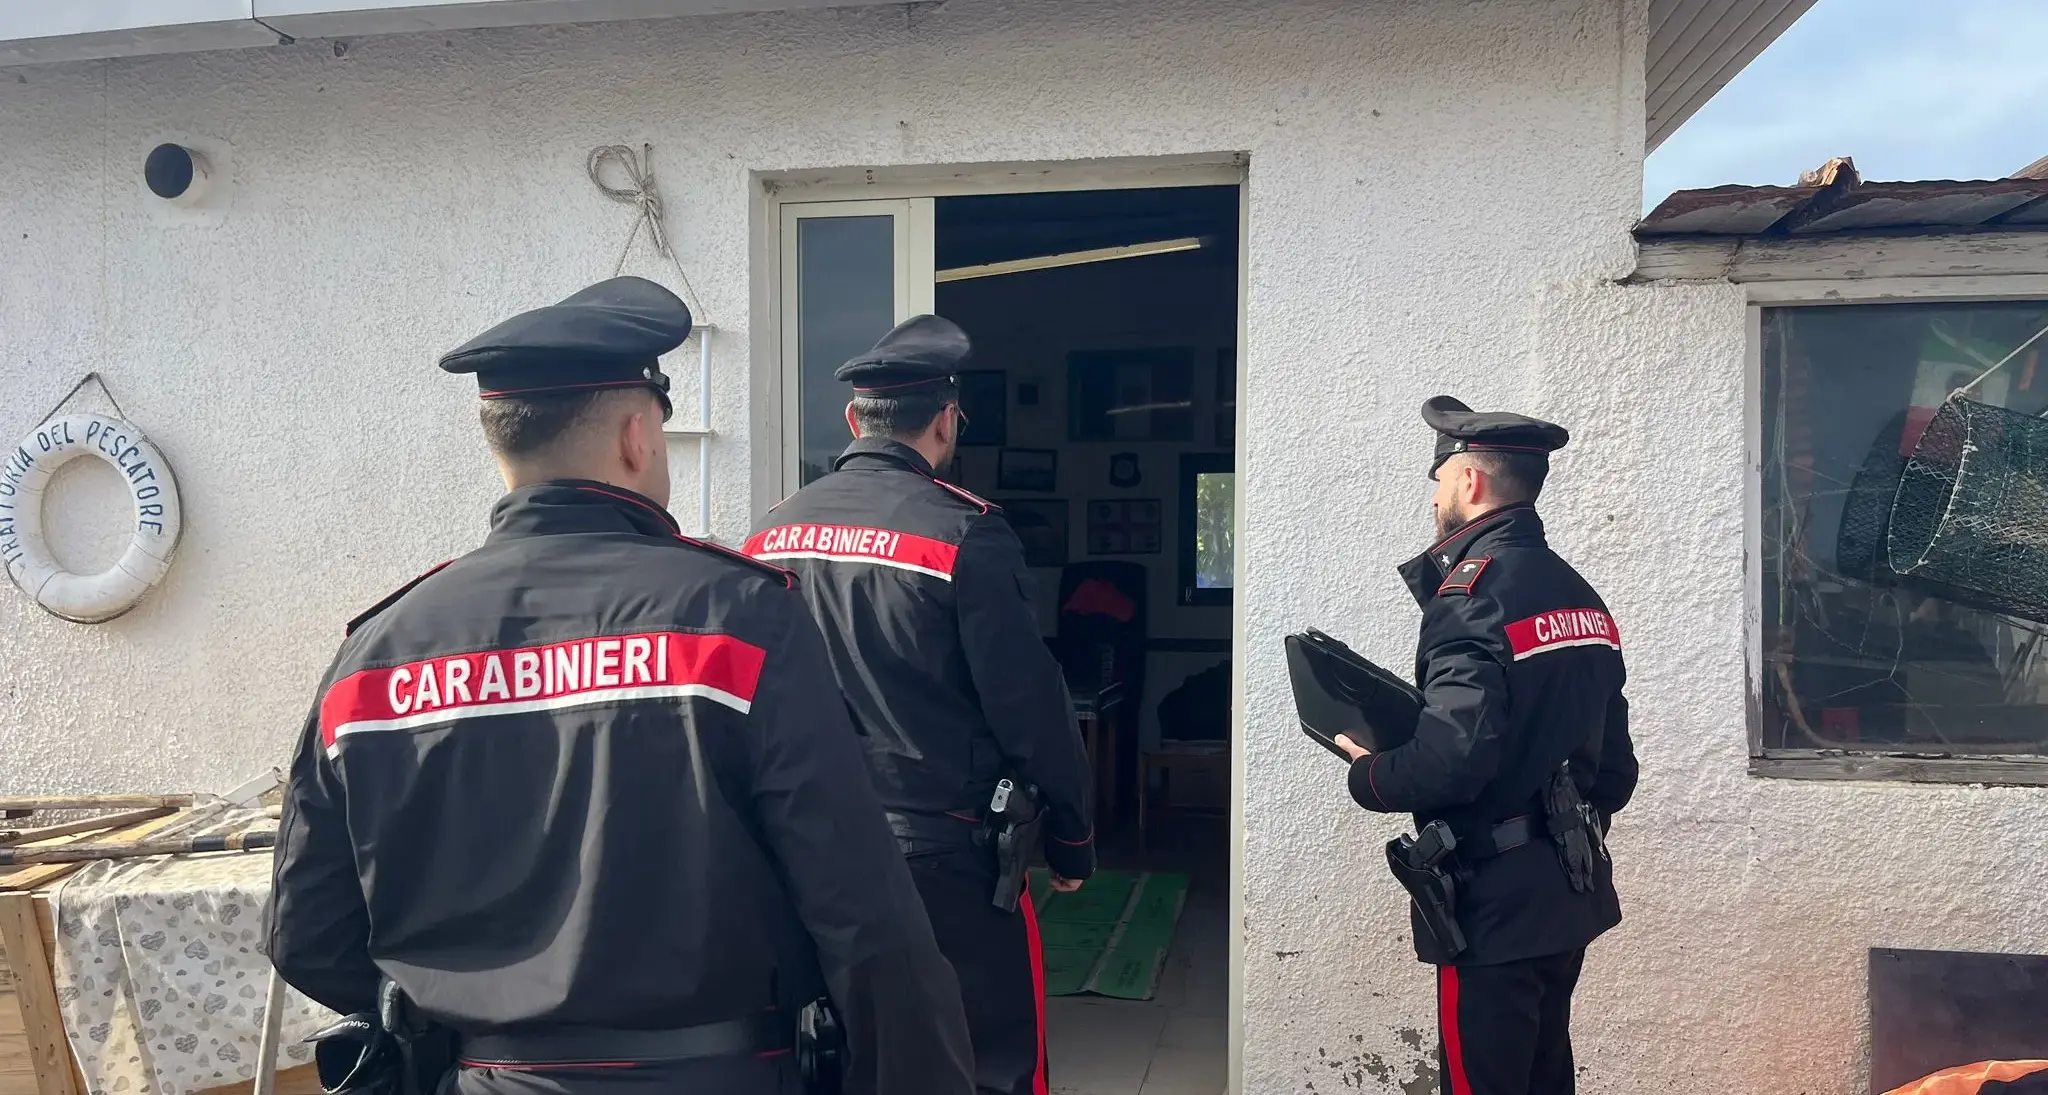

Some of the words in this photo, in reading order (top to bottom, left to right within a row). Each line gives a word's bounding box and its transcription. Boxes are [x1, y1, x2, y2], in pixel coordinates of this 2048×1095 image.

[37, 421, 75, 452] DEL
[86, 421, 164, 535] PESCATORE
[763, 525, 900, 557] CARABINIERI
[388, 635, 668, 715] CARABINIERI
